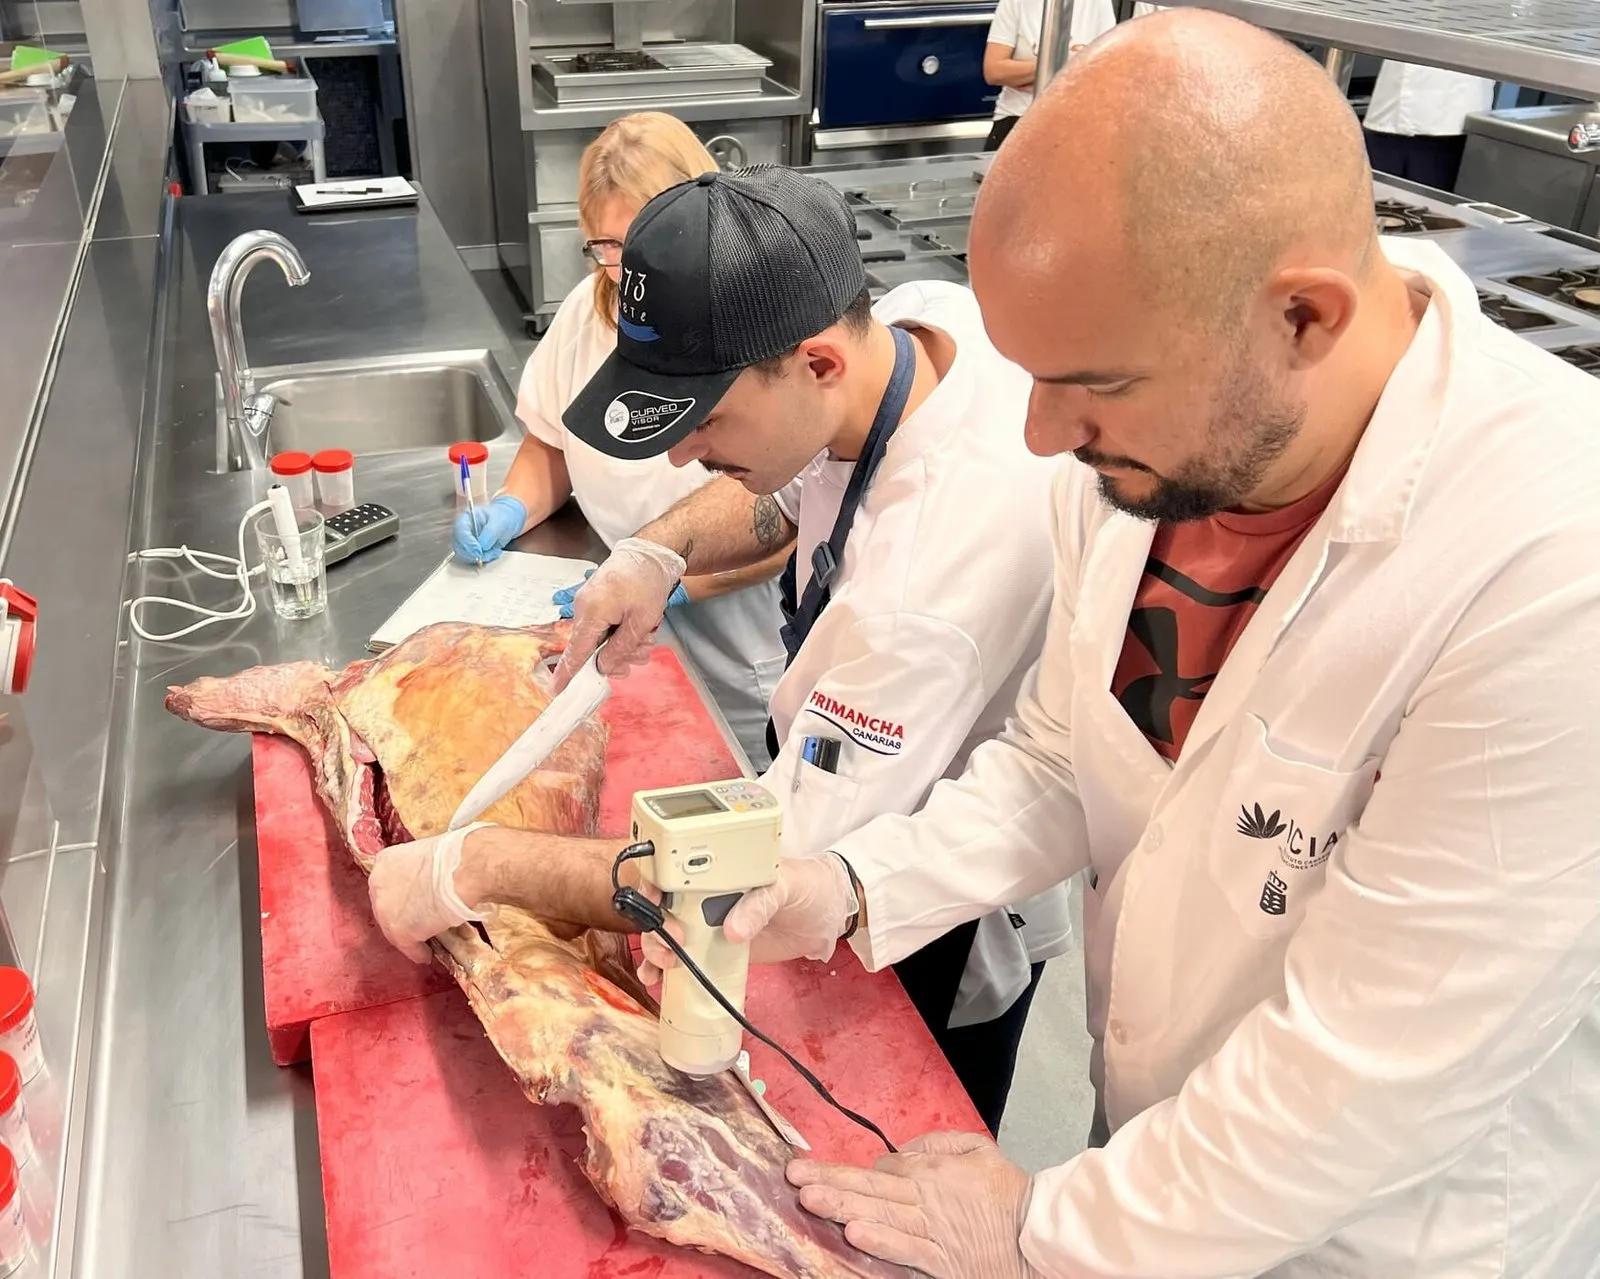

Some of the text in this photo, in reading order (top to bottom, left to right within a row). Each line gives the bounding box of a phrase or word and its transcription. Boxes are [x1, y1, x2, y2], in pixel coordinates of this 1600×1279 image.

[630, 403, 678, 419] CURVED
[631, 415, 660, 426] VISOR
[809, 691, 904, 739] FRIMANCHA
[852, 728, 902, 749] CANARIAS
